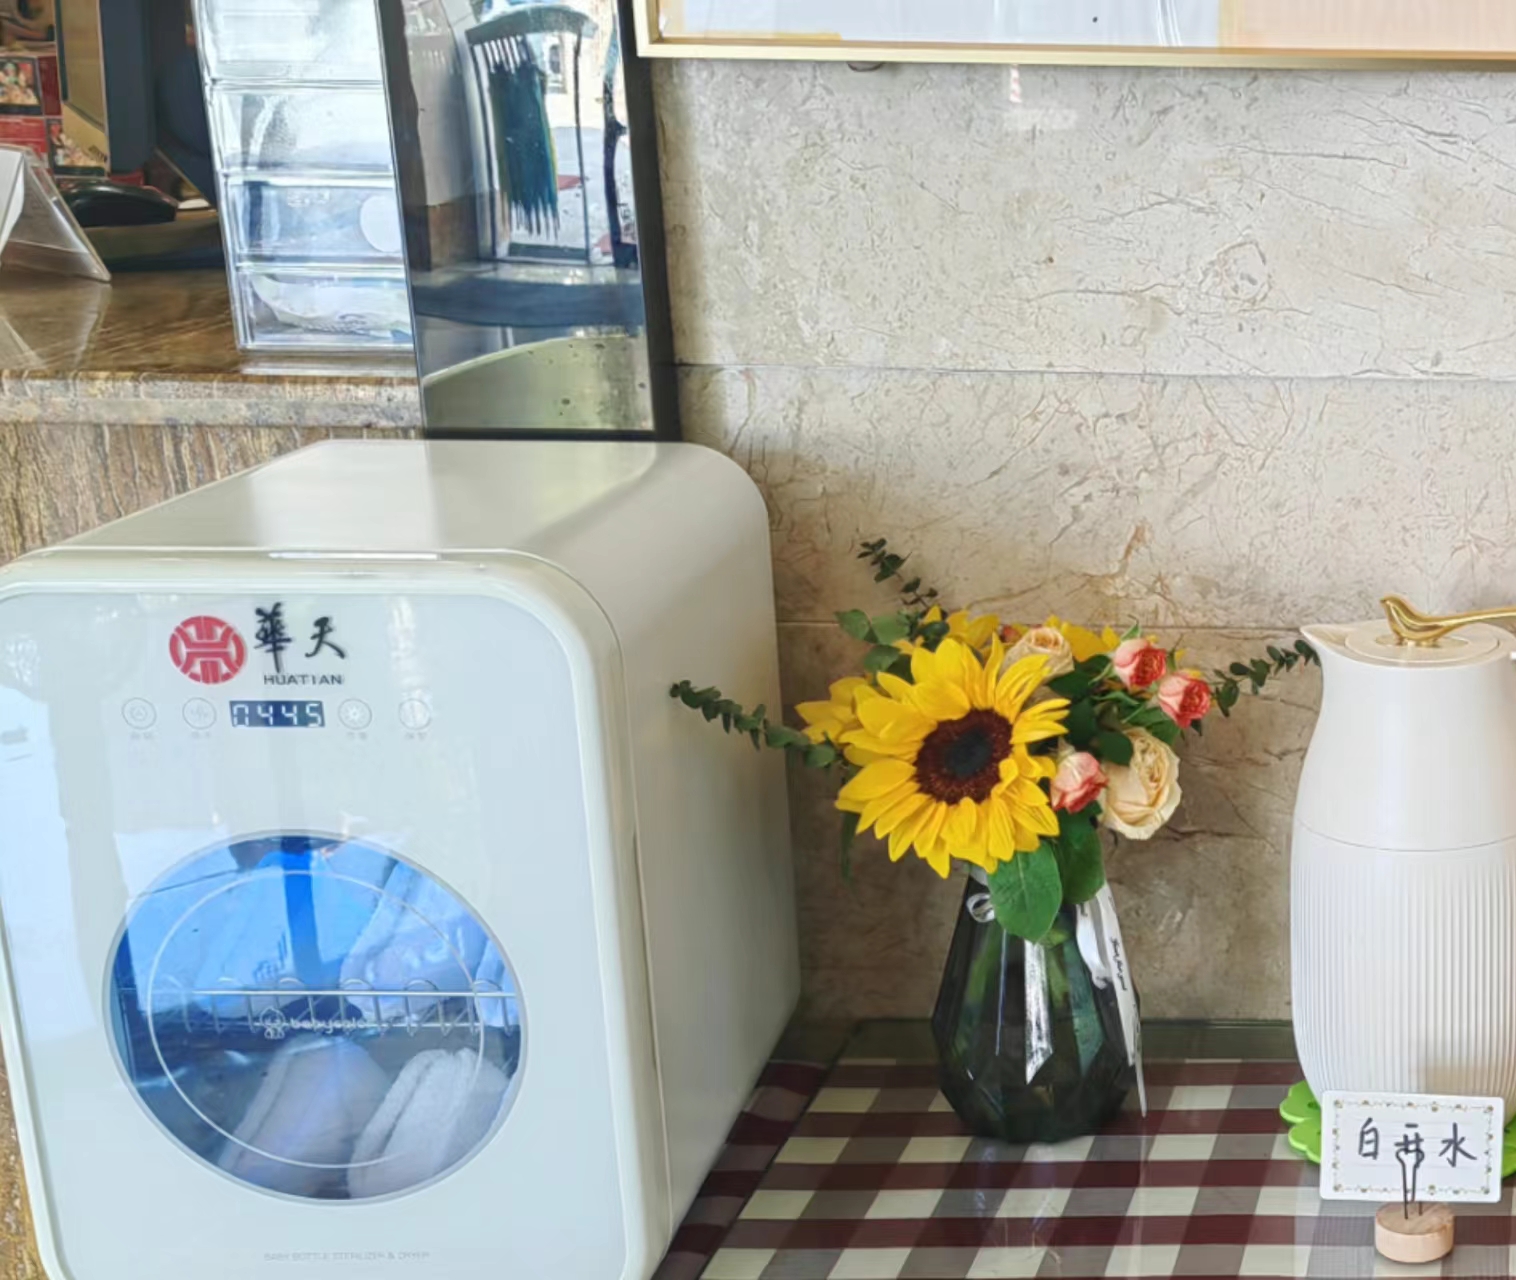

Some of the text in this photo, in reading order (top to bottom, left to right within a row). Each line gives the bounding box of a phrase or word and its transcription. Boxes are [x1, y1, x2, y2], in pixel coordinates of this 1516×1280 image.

[263, 674, 344, 685] HUATIAN
[232, 702, 321, 727] 0445
[1358, 1117, 1477, 1168] 白开水
